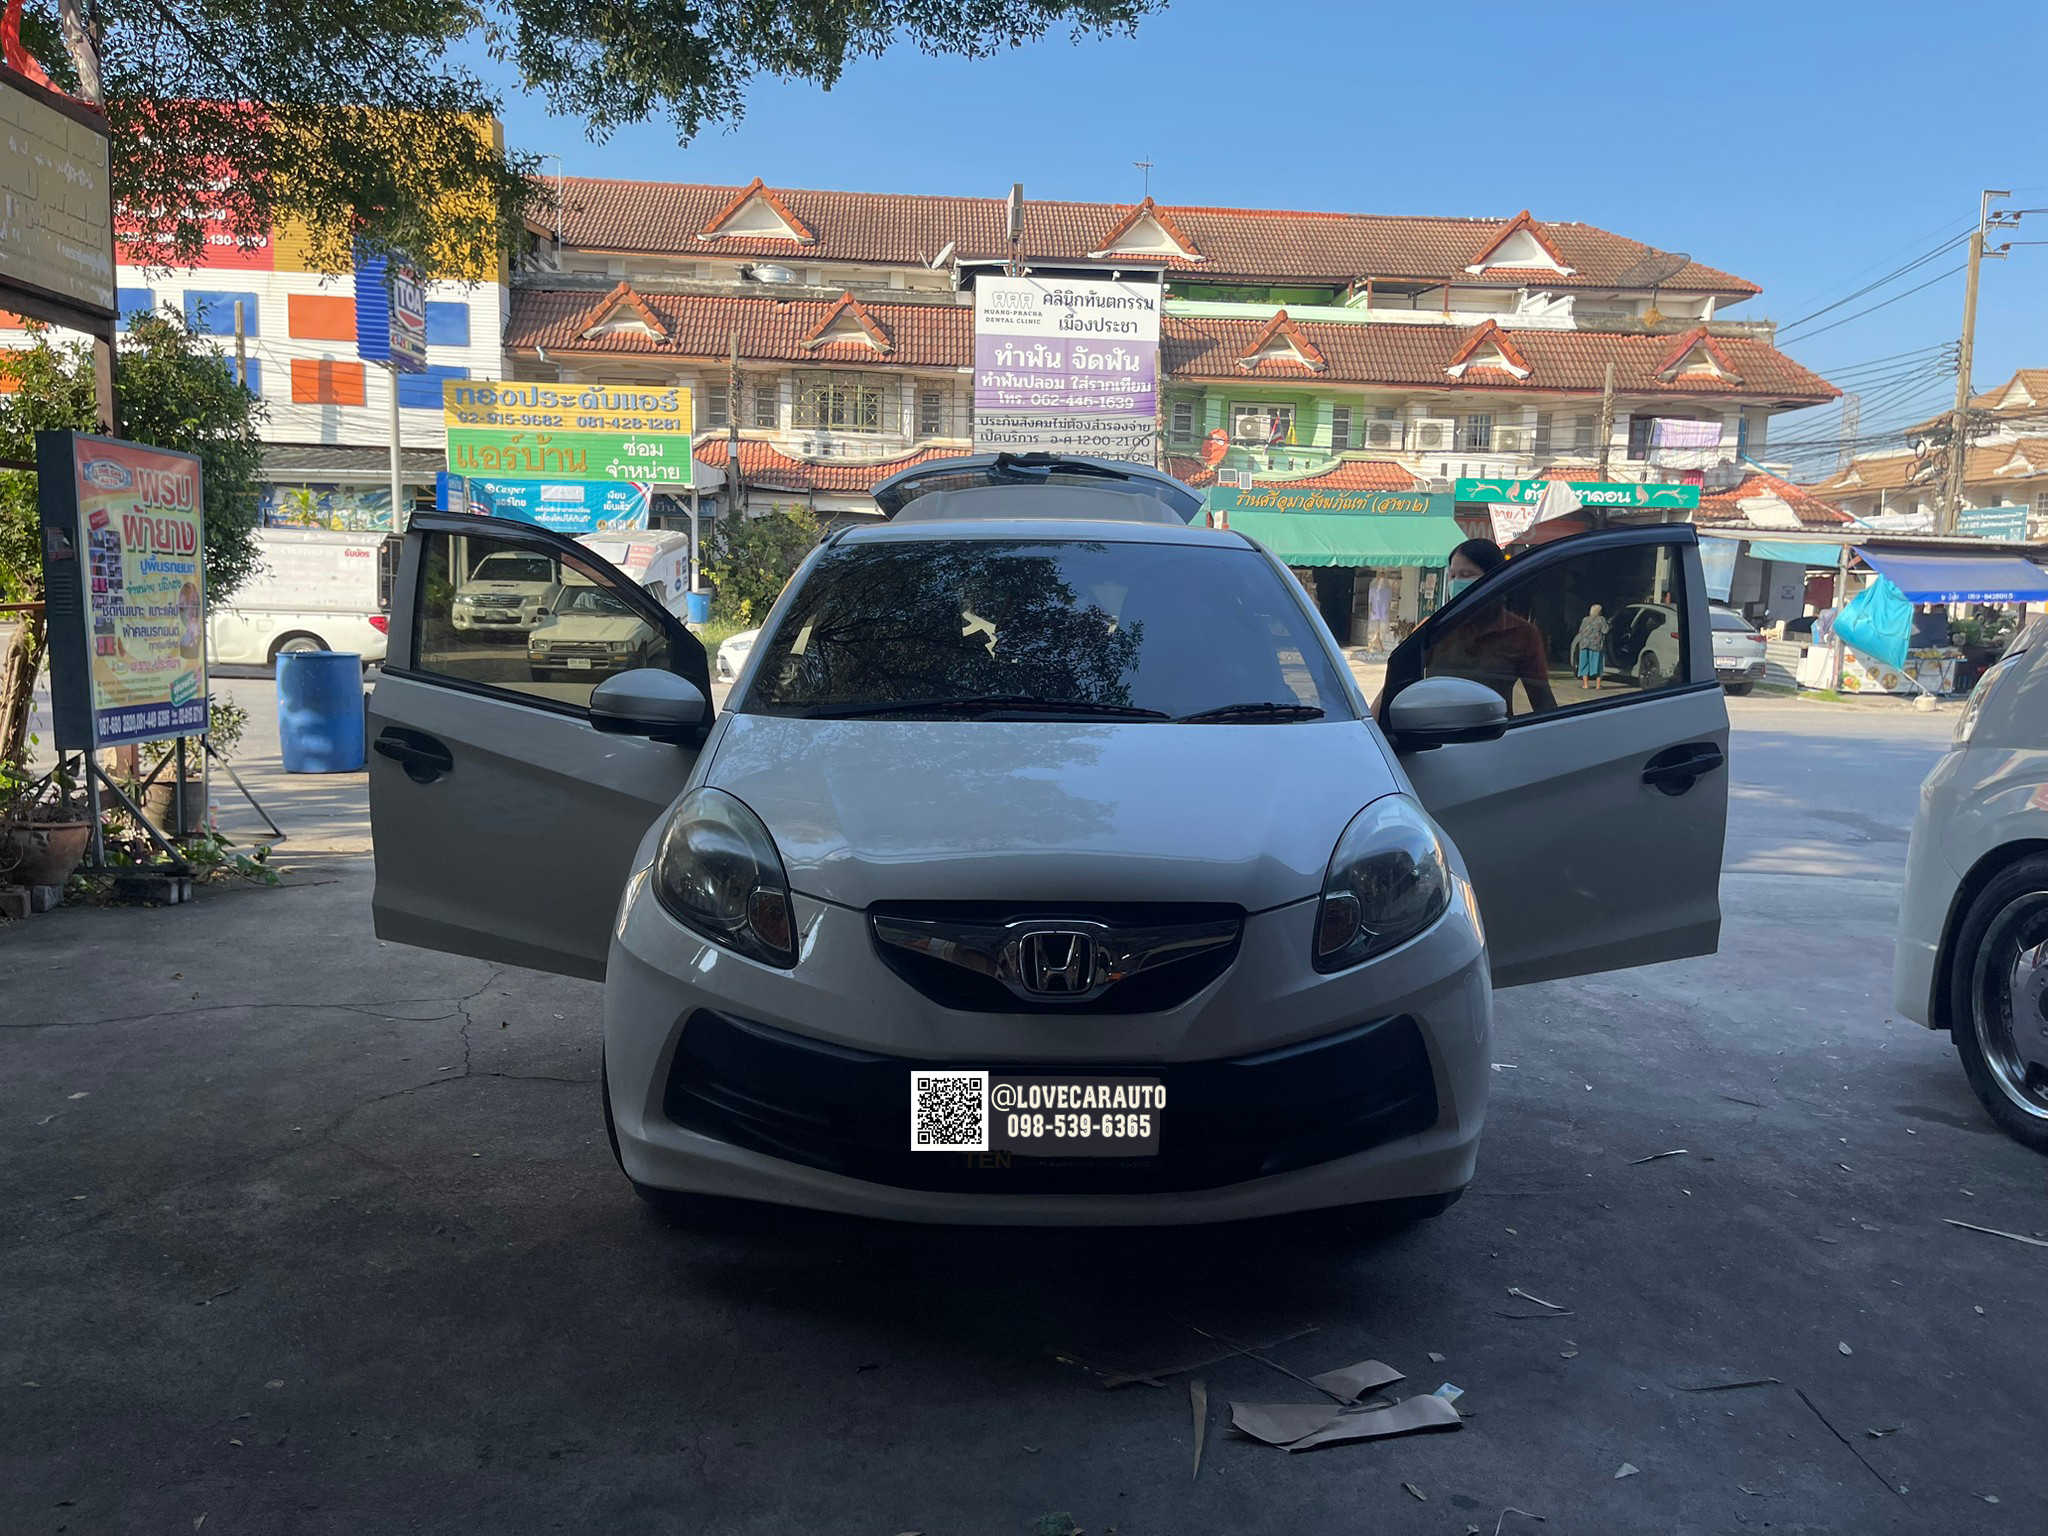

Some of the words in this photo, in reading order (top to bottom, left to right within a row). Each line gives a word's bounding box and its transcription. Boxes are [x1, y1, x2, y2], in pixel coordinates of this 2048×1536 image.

[398, 280, 422, 315] TOA
[1042, 290, 1154, 311] คลินิกทันตกรรม
[983, 308, 1043, 317] MUANG-PRACHA
[1058, 313, 1138, 334] เมืองประชา
[994, 342, 1061, 369] ทำฟัน
[1071, 346, 1140, 372] จัดฟัน
[981, 372, 1065, 390] ทำฟันปลอม
[1070, 375, 1152, 393] ใส่รากเทียม
[455, 386, 680, 414] ทองประดับแอร์
[998, 391, 1026, 405] โทร.
[457, 411, 564, 427] 02-915-9682
[576, 416, 681, 430] 081-428-1281
[623, 436, 664, 457] ซ่อม
[980, 429, 1039, 444] เปิดบริการ
[456, 433, 588, 473] แอร์บ้าน
[605, 459, 681, 480] จำหน่าย
[136, 468, 193, 511] พรม
[495, 485, 526, 496] Casper
[122, 505, 197, 555] ผ้ายาง
